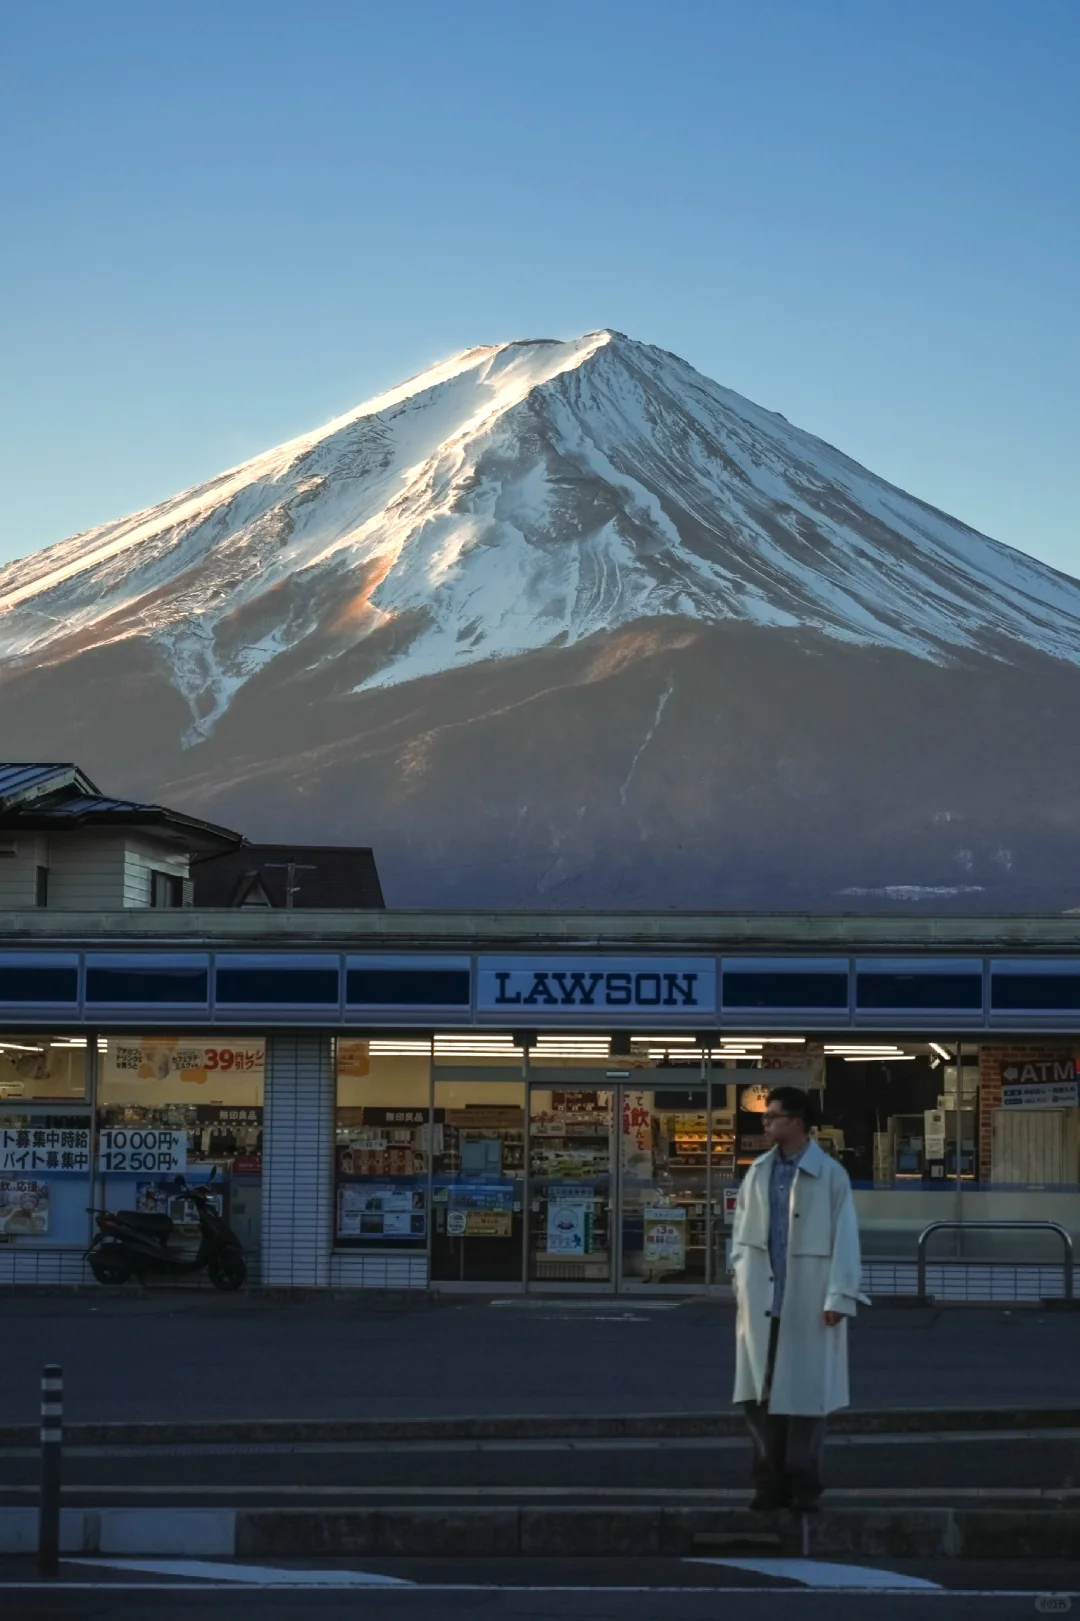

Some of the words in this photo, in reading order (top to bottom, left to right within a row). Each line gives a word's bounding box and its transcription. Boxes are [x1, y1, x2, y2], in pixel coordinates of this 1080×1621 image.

[494, 972, 698, 1005] LAWSON
[203, 1049, 235, 1071] 39
[1020, 1062, 1075, 1082] ATM
[219, 1110, 257, 1120] 無印良品
[385, 1112, 424, 1122] 無印良品
[3, 1130, 88, 1149] ト募集中時給
[3, 1151, 88, 1170] バイト募集中
